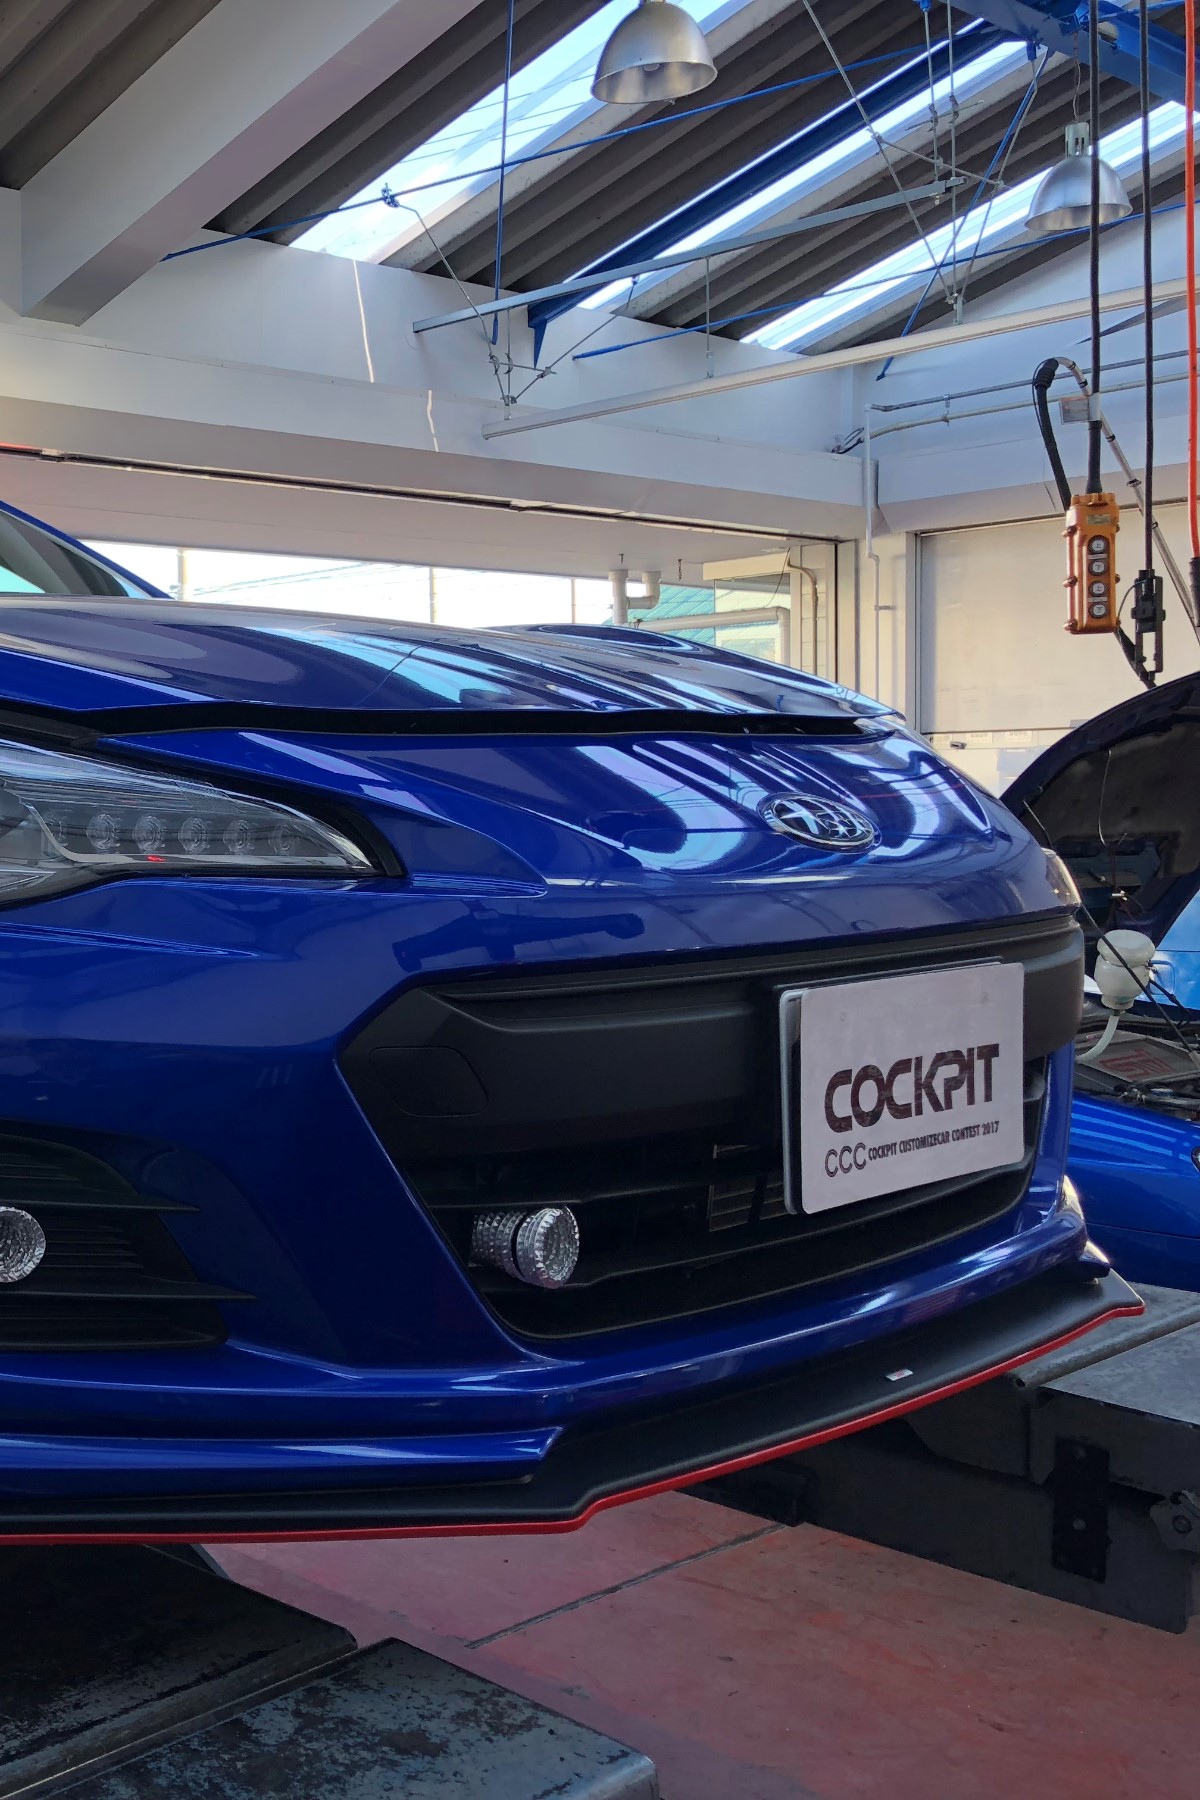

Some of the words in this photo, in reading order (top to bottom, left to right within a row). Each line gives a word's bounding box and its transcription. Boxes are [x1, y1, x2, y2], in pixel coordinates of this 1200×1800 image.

[824, 1043, 1000, 1133] COCKPIT
[824, 1142, 867, 1178] CCC
[868, 1141, 898, 1161] COCKPIT
[898, 1130, 950, 1154] CUSTOMIZECAR
[951, 1124, 980, 1143] CONTEST
[981, 1120, 1000, 1136] 2017
